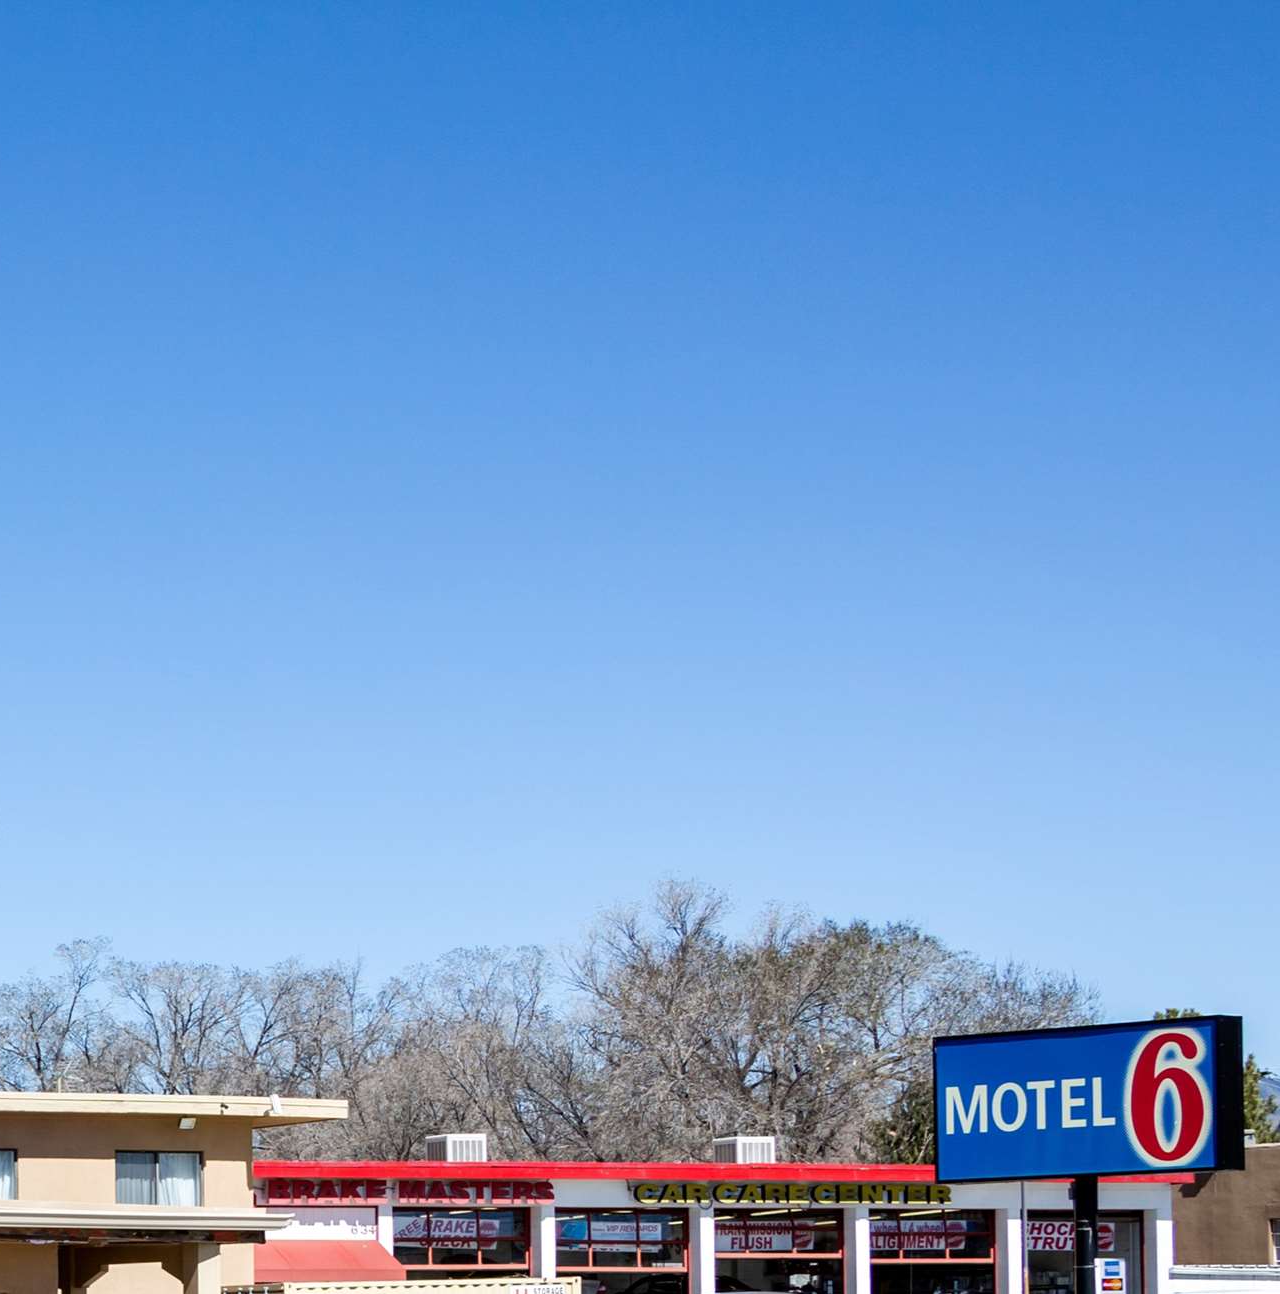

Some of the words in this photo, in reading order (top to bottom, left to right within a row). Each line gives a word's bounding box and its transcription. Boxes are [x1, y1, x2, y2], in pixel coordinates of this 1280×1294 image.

[945, 1077, 1116, 1135] MOTEL
[1127, 1030, 1208, 1165] 6
[267, 1179, 388, 1205] BRAKE
[398, 1180, 555, 1205] MASTERS
[634, 1183, 710, 1204] CAR
[712, 1183, 810, 1204] CARE
[811, 1183, 952, 1204] CENTER
[874, 1222, 898, 1233] whee
[731, 1237, 772, 1249] FLUSH
